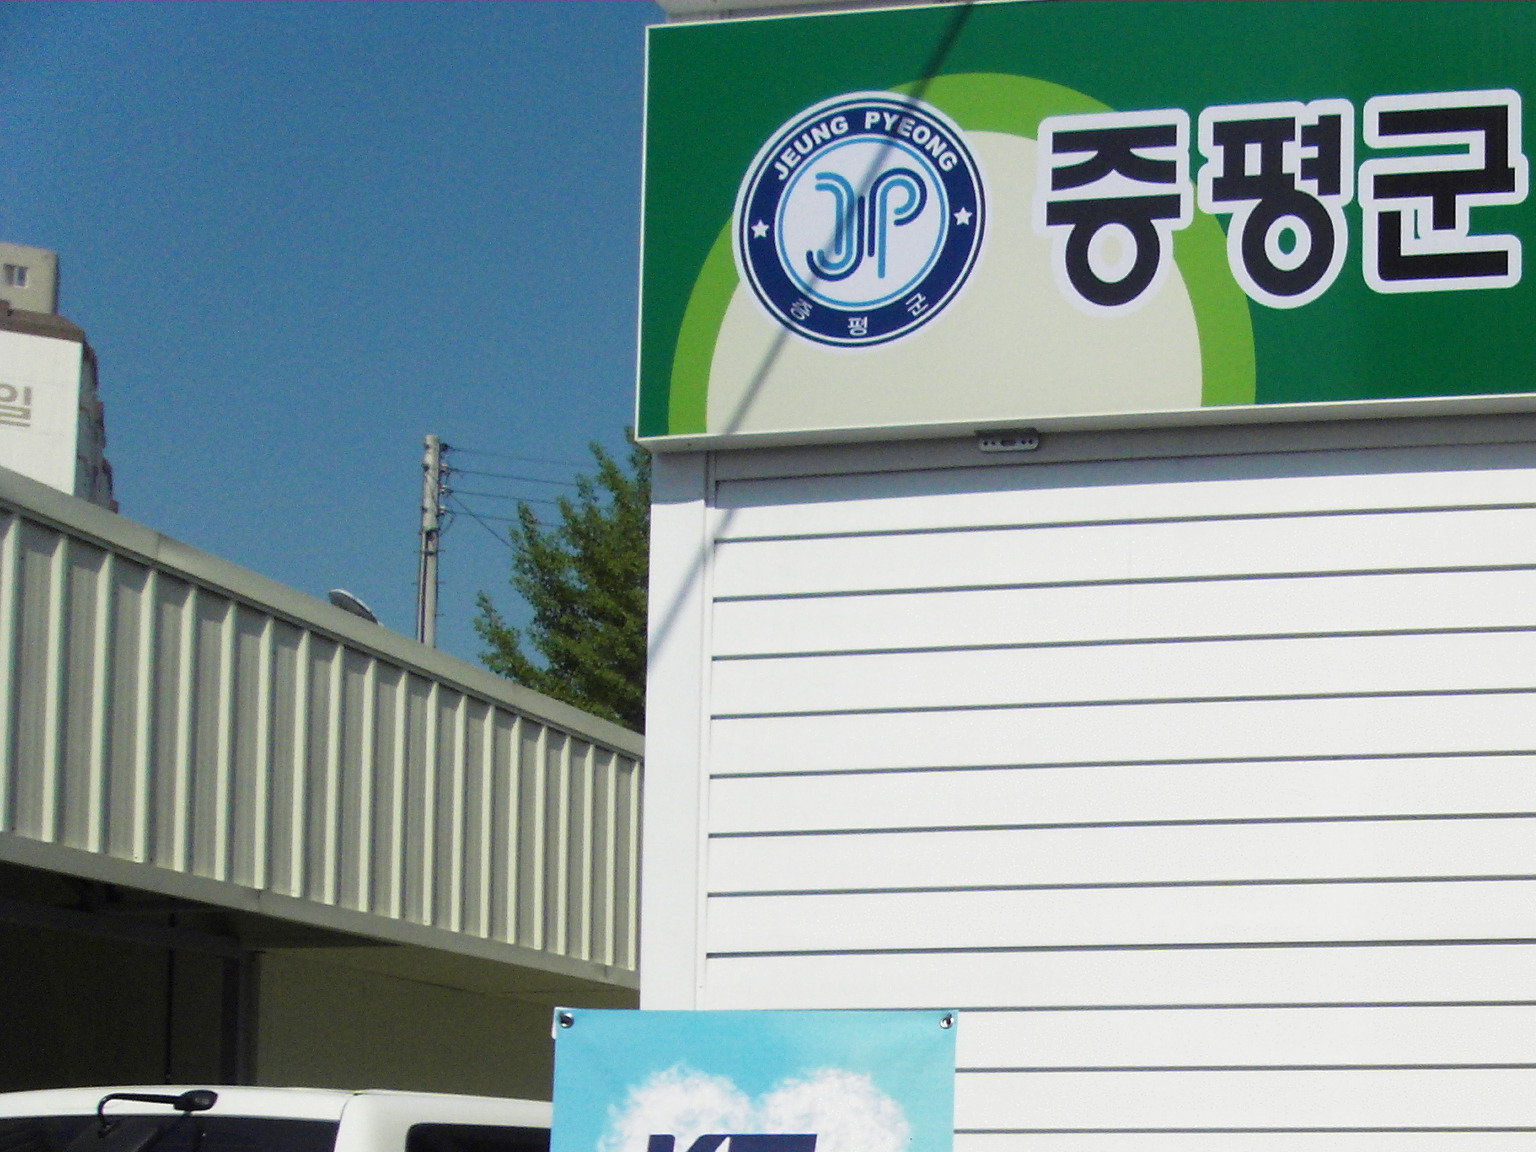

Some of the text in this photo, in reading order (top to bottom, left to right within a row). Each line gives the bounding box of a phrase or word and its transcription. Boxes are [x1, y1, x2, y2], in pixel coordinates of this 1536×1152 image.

[773, 111, 958, 181] JEUNG PYEONG
[1044, 98, 1519, 310] 증평군
